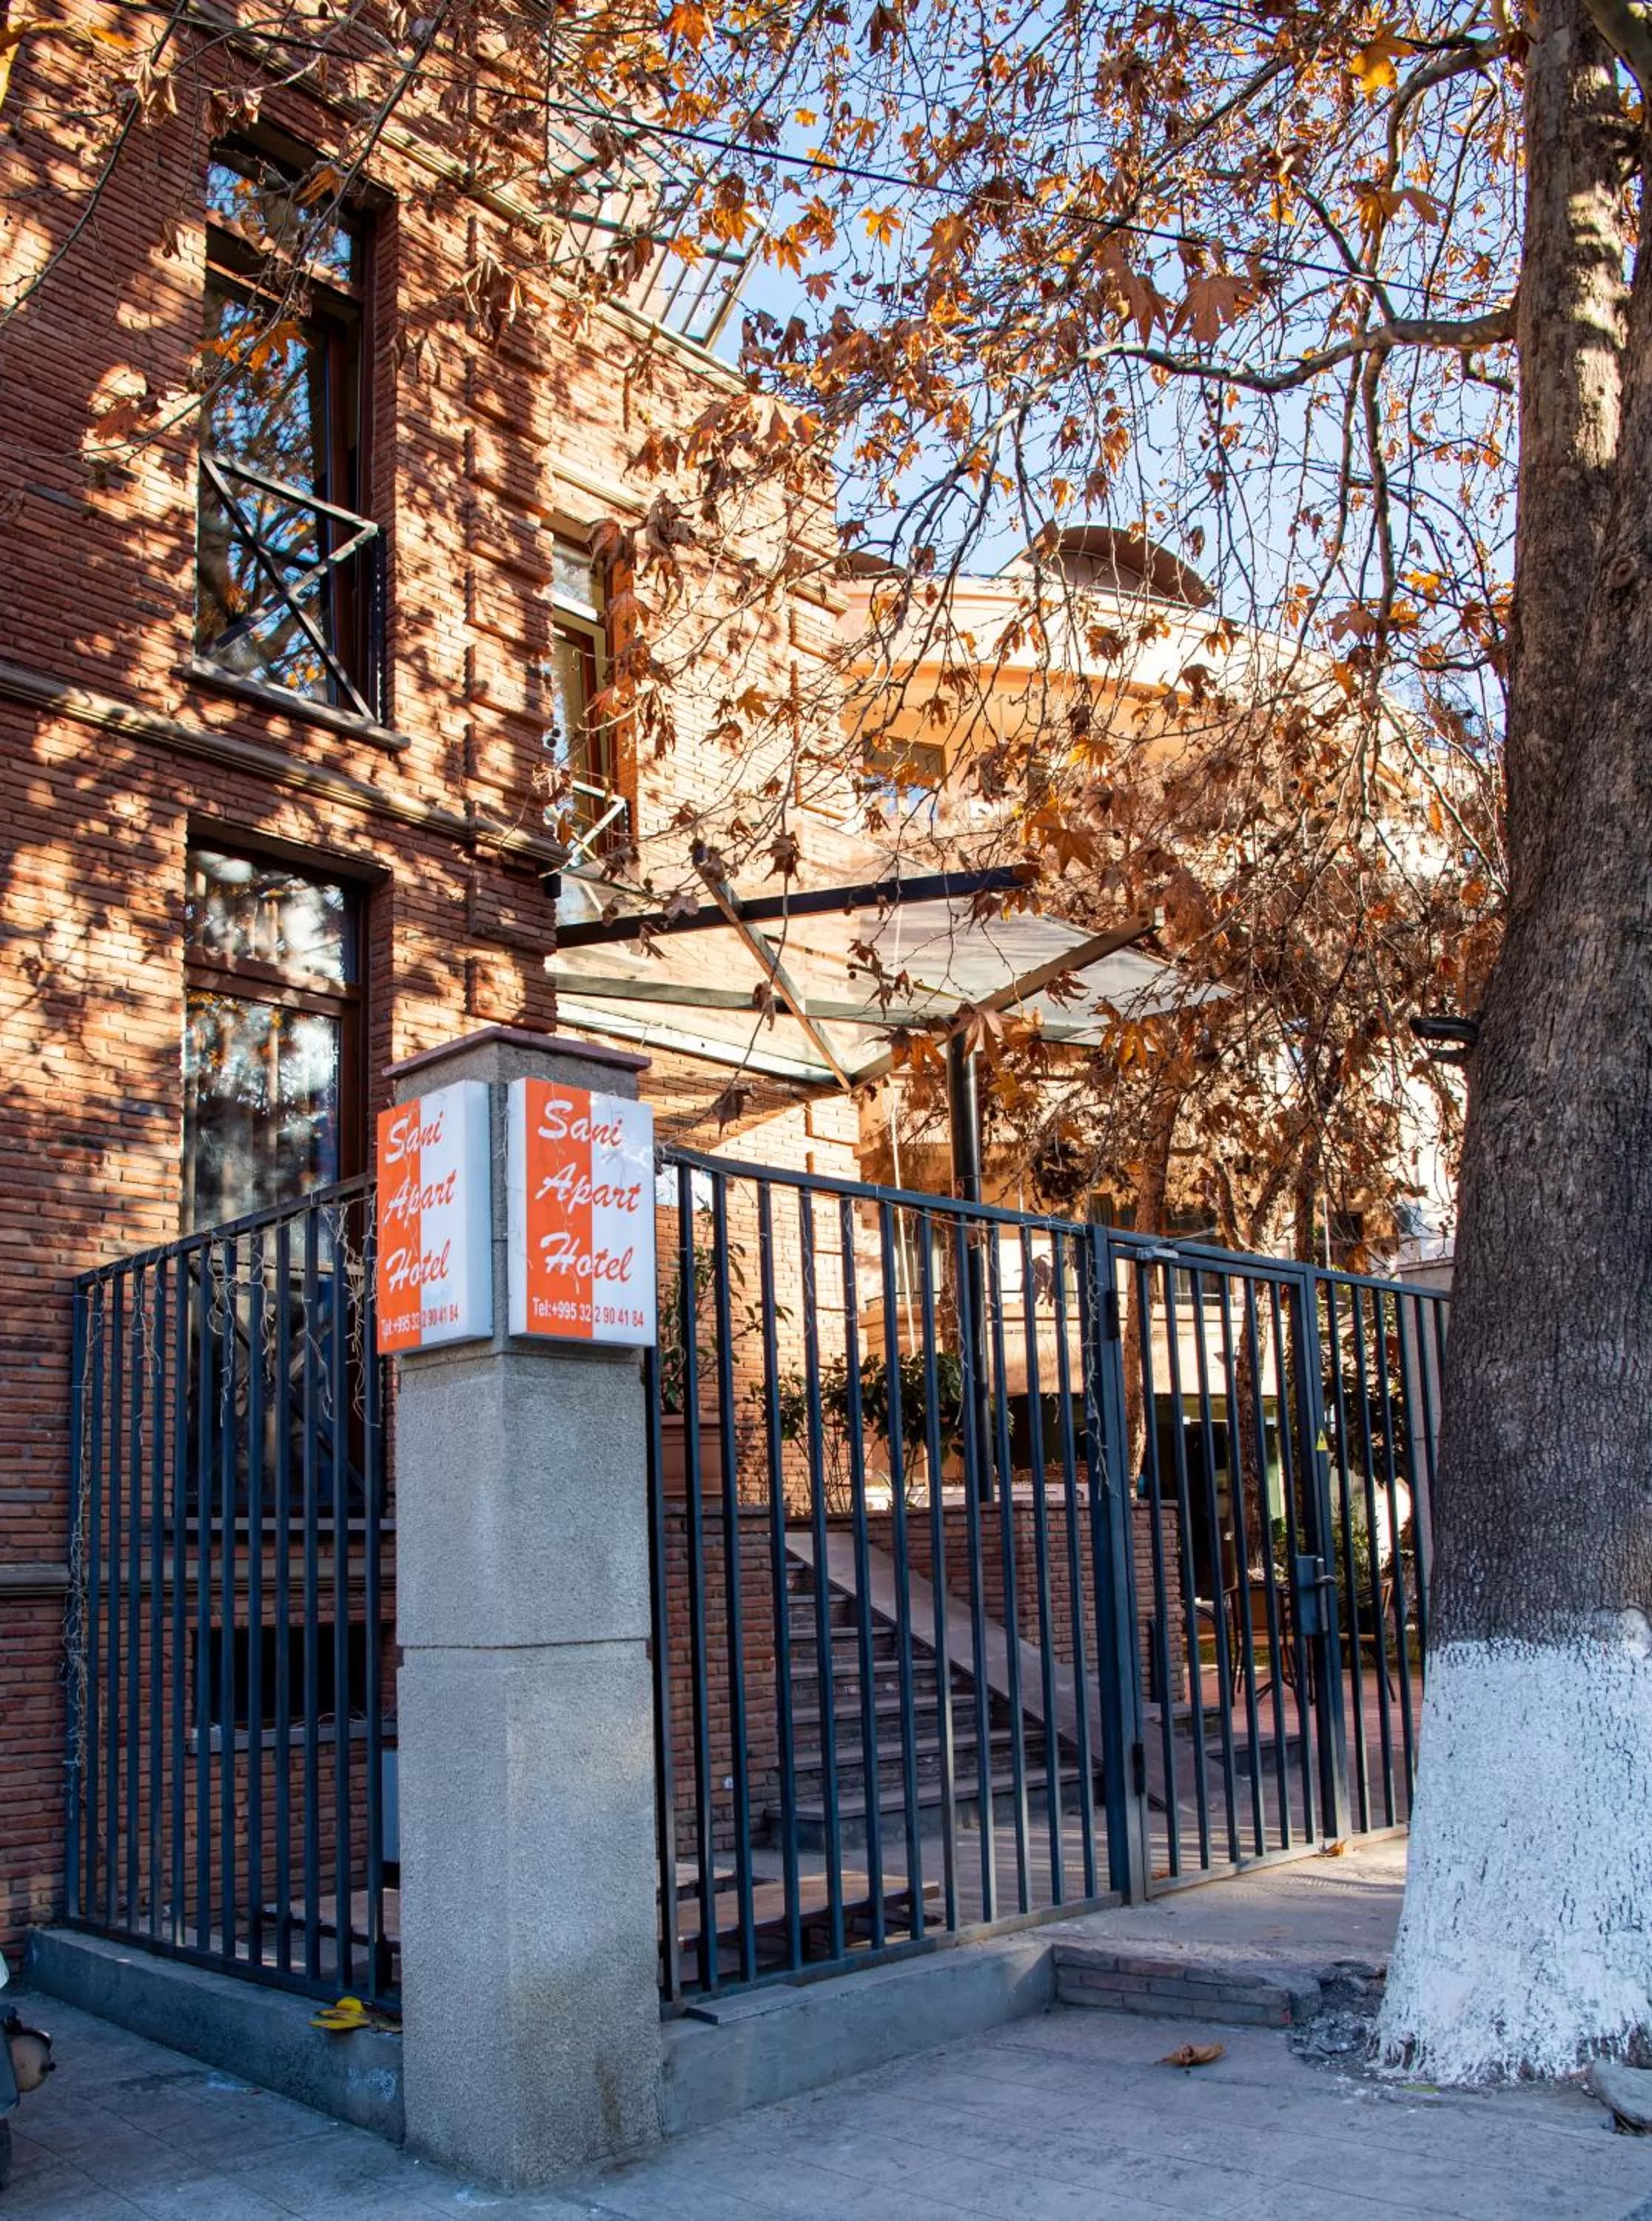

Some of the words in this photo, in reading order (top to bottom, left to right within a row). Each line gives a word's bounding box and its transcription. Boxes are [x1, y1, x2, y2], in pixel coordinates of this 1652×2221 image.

[385, 1110, 445, 1164] Sani
[537, 1099, 624, 1147] Sani
[384, 1169, 457, 1228] Apart
[534, 1162, 643, 1214] Apart
[386, 1237, 451, 1293] Hotel
[540, 1231, 634, 1282] Hotel
[532, 1296, 577, 1321] Tel:+995
[579, 1303, 591, 1322] 32
[594, 1305, 600, 1323] 2
[603, 1306, 615, 1325] 90
[617, 1307, 628, 1327] 41
